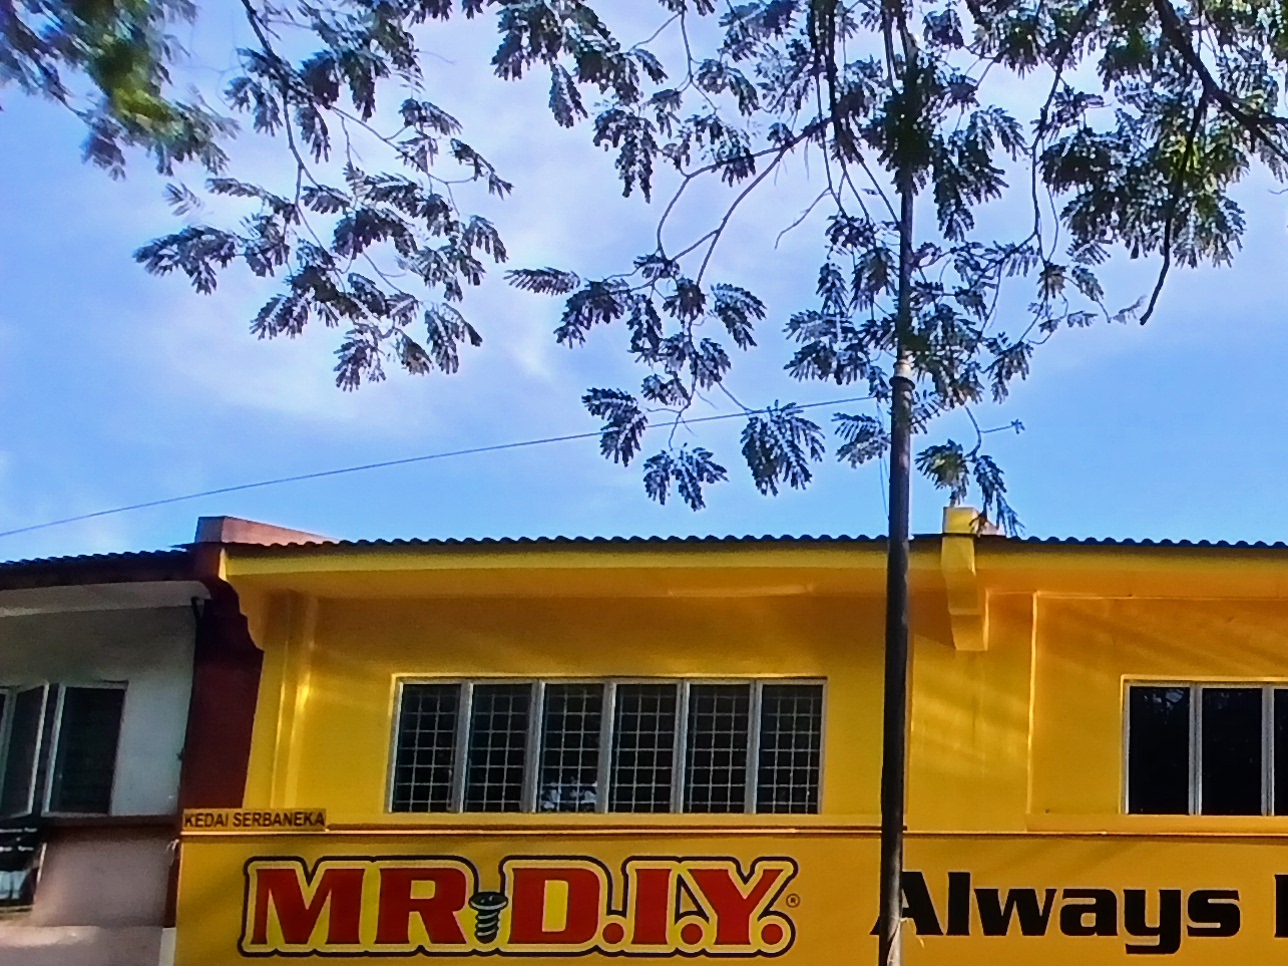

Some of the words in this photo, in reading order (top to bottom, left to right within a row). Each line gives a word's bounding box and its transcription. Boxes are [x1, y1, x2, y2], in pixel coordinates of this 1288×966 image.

[184, 813, 229, 828] KEDAI
[232, 812, 326, 828] SERBANEKA
[869, 871, 1241, 955] Always
